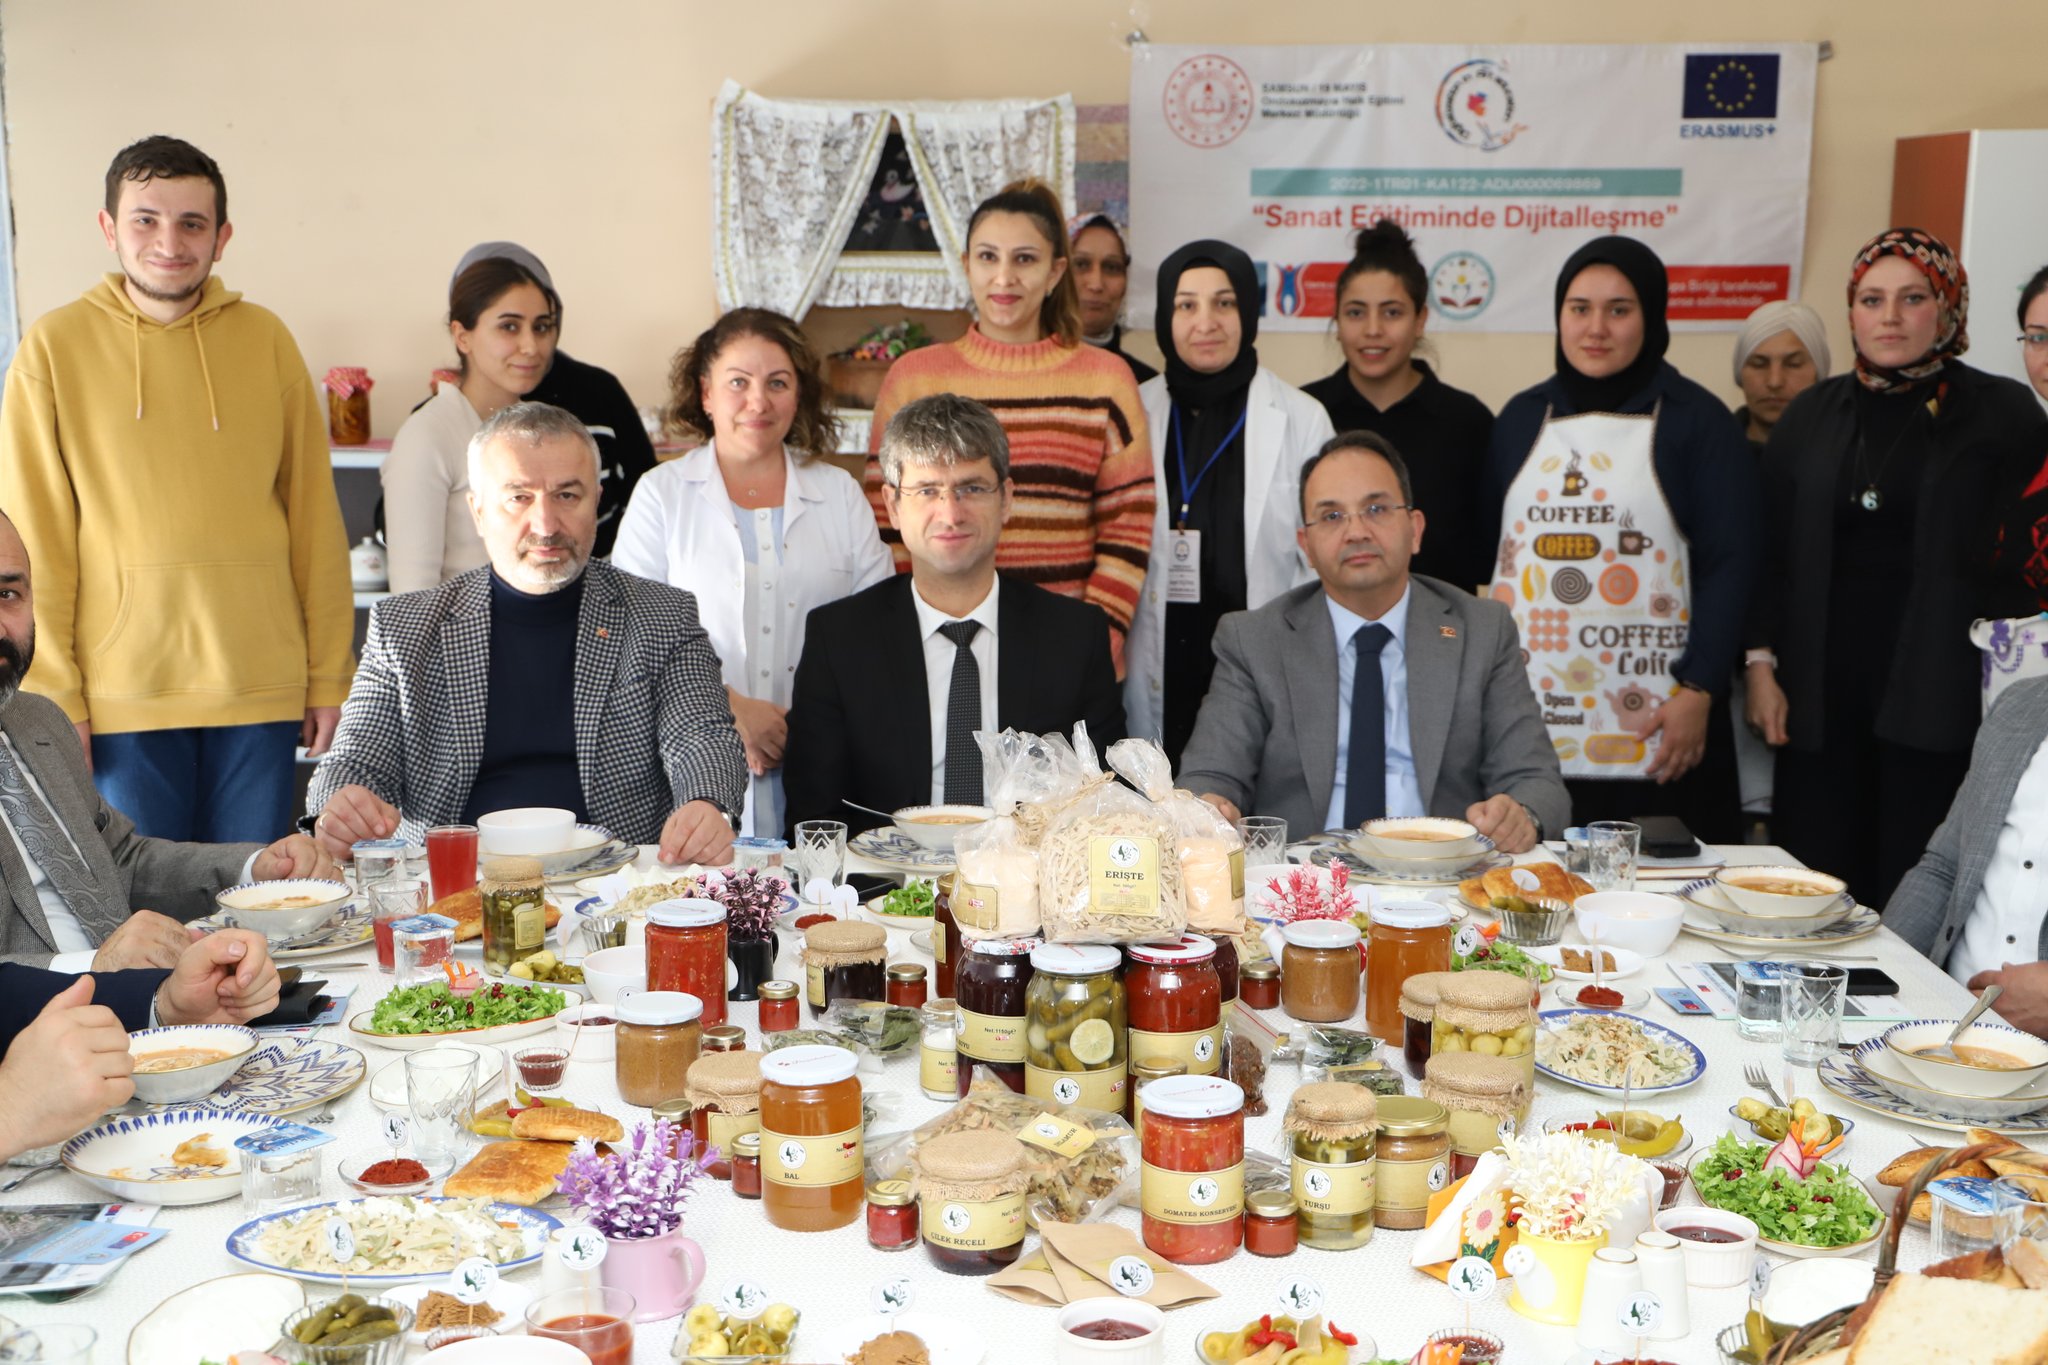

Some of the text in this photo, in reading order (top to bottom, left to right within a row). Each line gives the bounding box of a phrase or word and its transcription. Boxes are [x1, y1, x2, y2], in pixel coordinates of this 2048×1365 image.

[1680, 124, 1776, 138] ERASMUS+
[1253, 204, 1343, 228] “Sanat
[1527, 505, 1615, 524] COFFEE
[1536, 535, 1596, 557] COFFEE
[1579, 624, 1688, 649] COFFEE
[1617, 651, 1672, 676] Coff
[1544, 693, 1575, 708] Open
[1544, 712, 1584, 725] Closed
[1105, 870, 1145, 882] ERİŞTE
[784, 1172, 800, 1180] BAL
[1304, 1200, 1331, 1210] TURŞU
[1163, 1208, 1198, 1217] DOMATES
